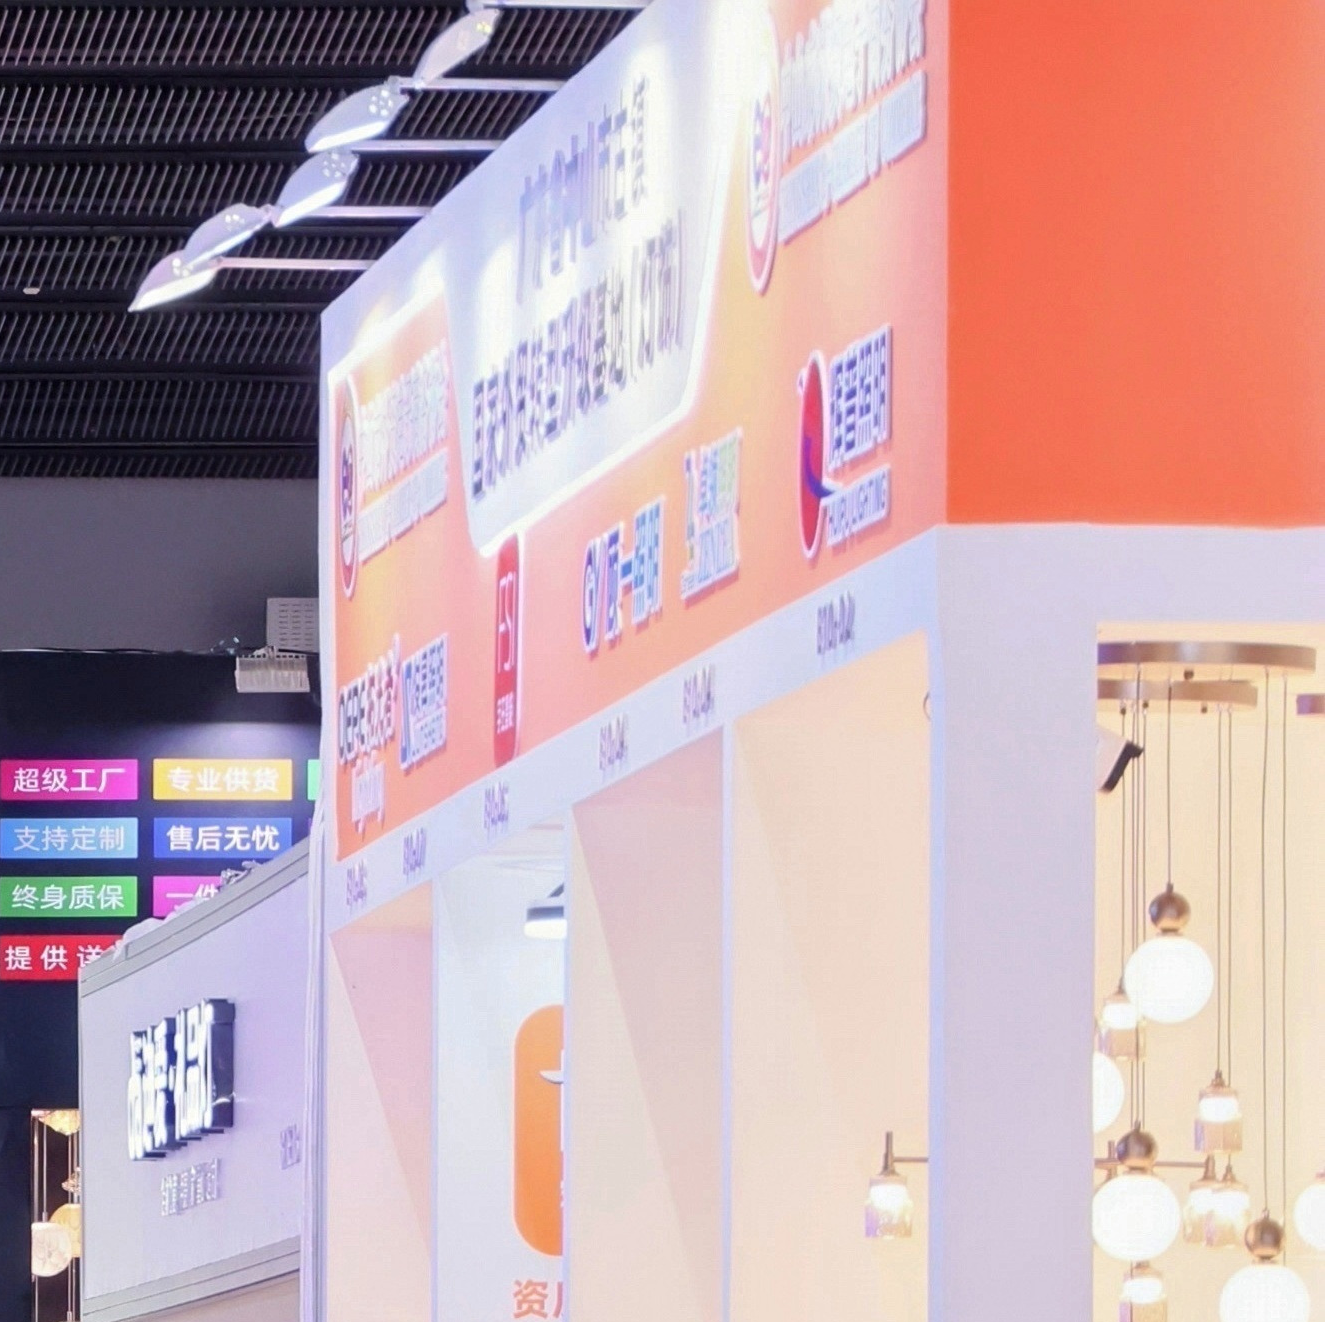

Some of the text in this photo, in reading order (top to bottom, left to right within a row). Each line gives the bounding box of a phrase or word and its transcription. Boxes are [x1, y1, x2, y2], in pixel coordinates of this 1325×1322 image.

[12, 766, 280, 794] 超级工厂 专业供货
[13, 825, 280, 852] 支持定制 售后无忧
[11, 884, 125, 910] 终身质保
